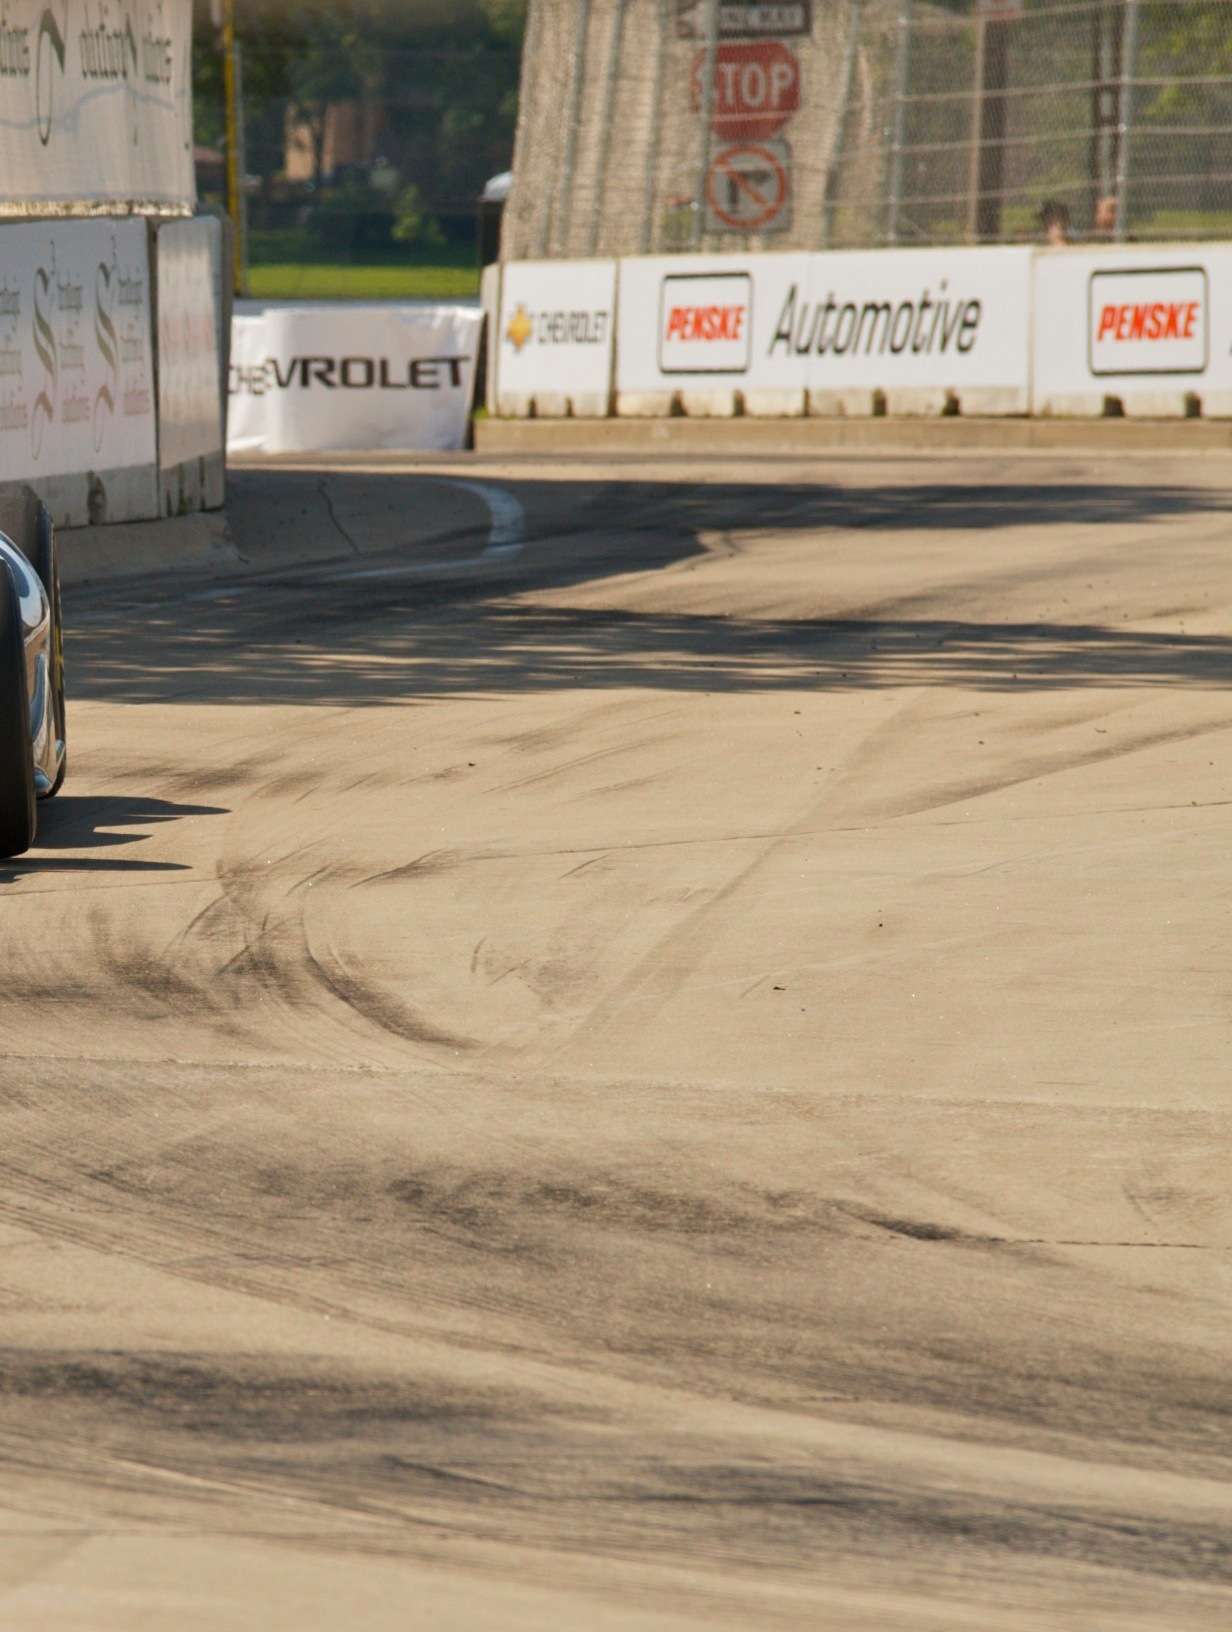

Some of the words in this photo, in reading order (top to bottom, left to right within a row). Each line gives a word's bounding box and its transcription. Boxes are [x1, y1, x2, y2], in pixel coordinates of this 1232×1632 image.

[536, 311, 608, 344] CHEVROLET
[667, 305, 746, 341] PENSKE
[769, 279, 982, 358] Automotive
[1097, 302, 1199, 341] PENSKE
